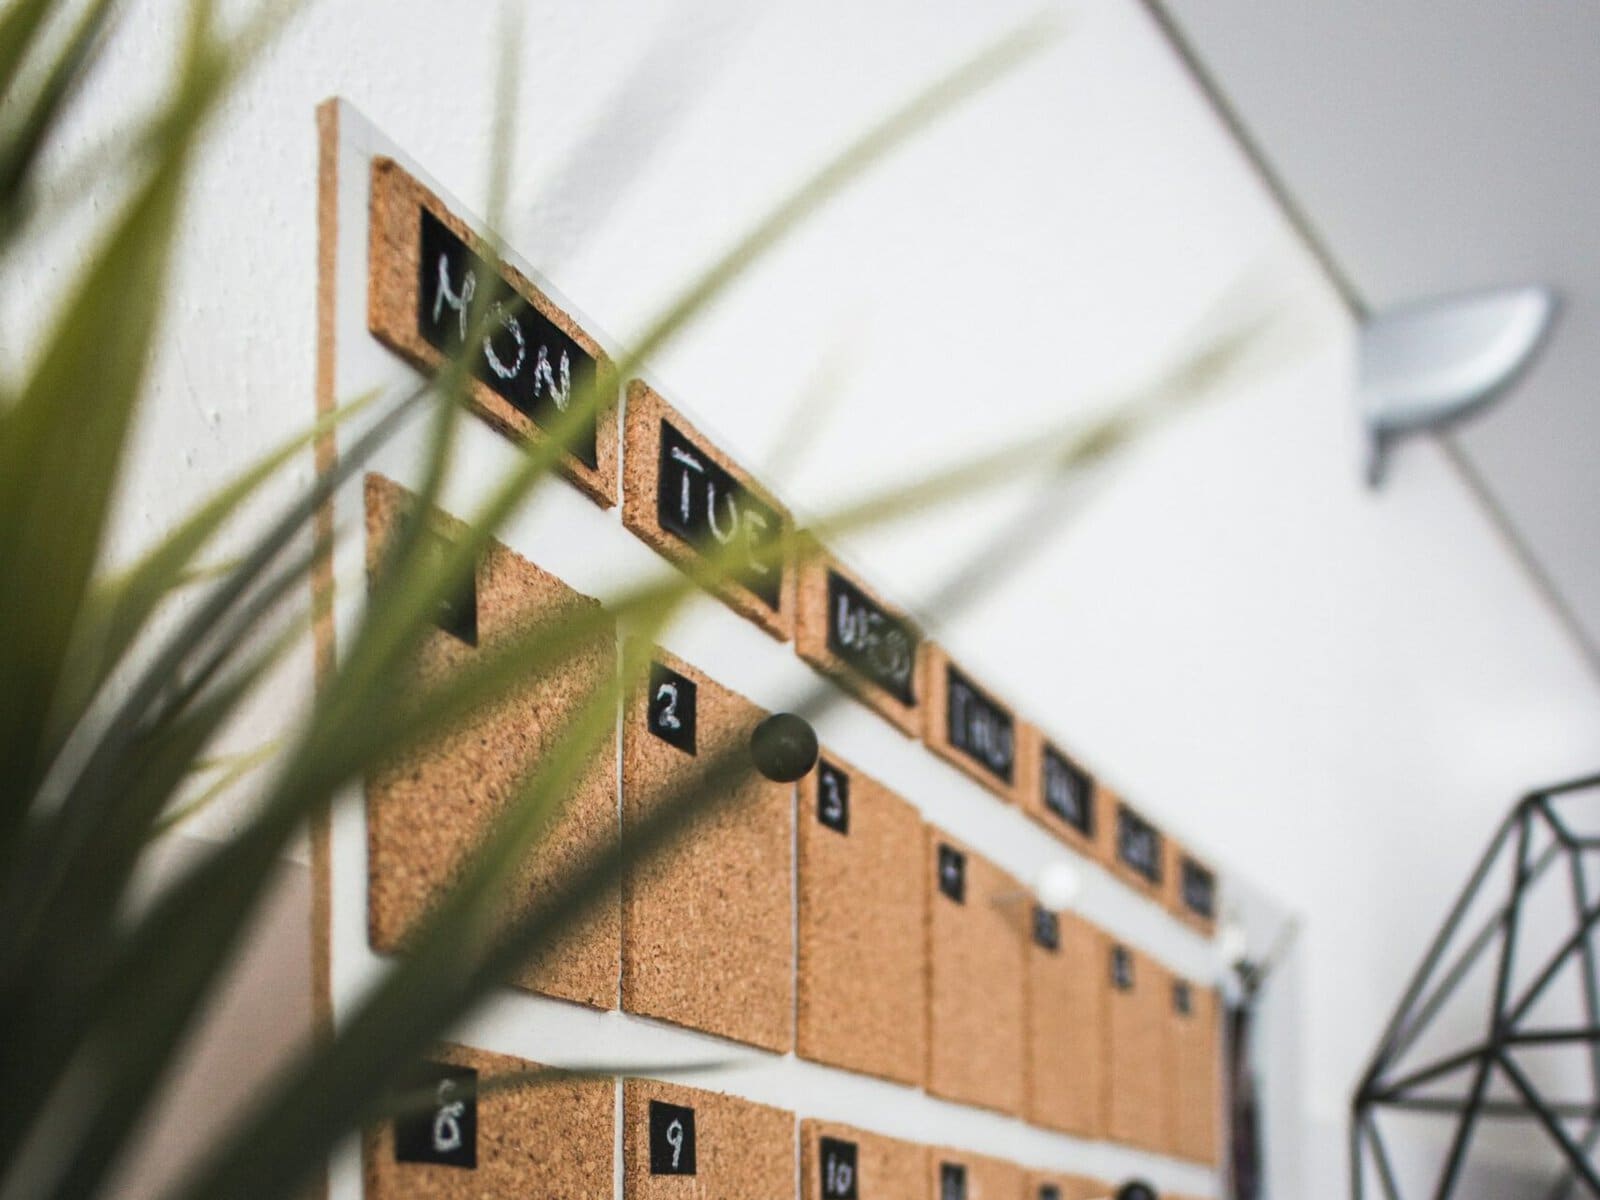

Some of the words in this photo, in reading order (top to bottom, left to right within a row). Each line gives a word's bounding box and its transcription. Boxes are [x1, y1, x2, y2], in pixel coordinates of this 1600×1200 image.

[433, 252, 571, 412] MON
[671, 446, 768, 574] TUE
[656, 682, 681, 729] 2
[432, 1077, 465, 1152] 8
[666, 1117, 684, 1170] 9
[827, 1152, 853, 1195] 10
